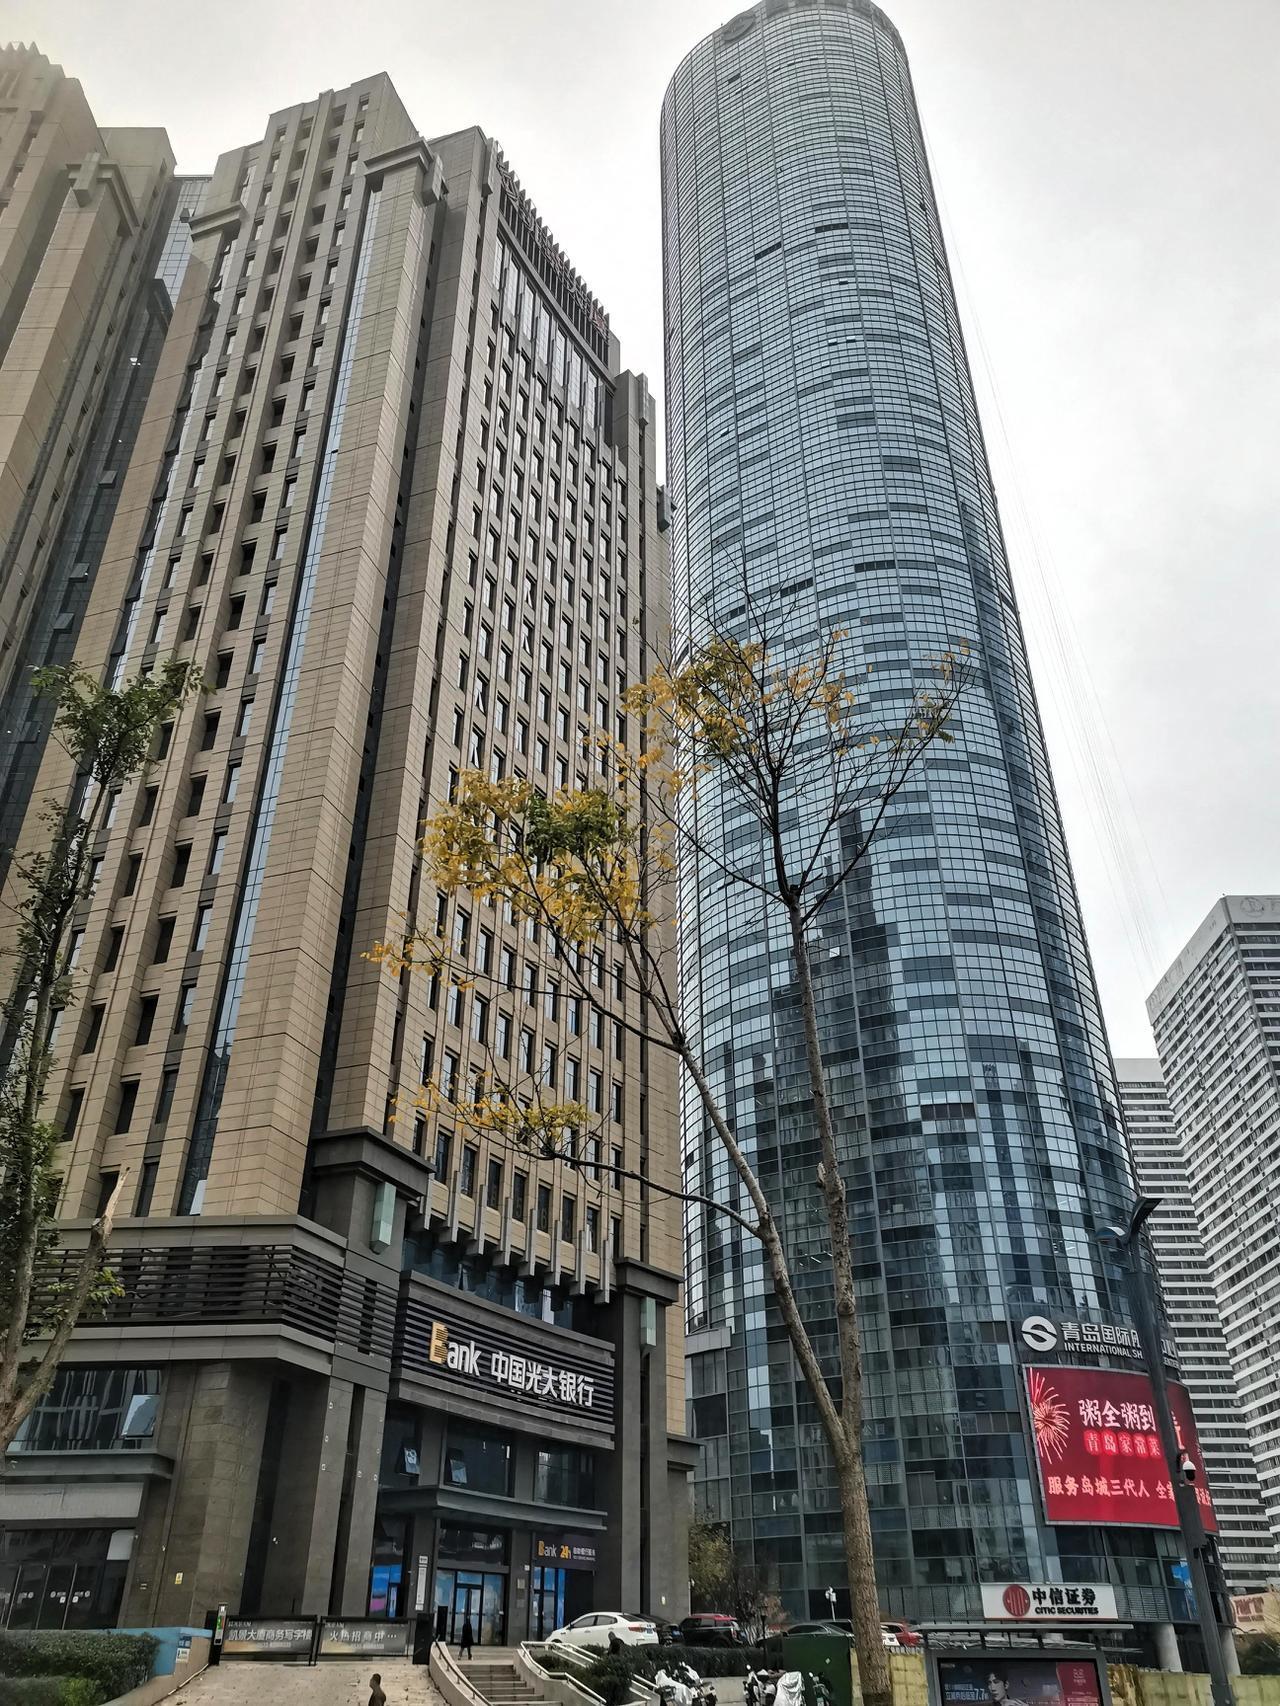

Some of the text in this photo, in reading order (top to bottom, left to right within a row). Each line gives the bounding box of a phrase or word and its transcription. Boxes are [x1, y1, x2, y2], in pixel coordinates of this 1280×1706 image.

[1063, 1342, 1131, 1359] INTERNATIONAL
[429, 1321, 595, 1407] Bank 中国光大银行
[1086, 1432, 1161, 1456] 青岛家常菜
[1047, 1475, 1150, 1498] 服务岛城三代人
[1031, 1587, 1096, 1606] 中信证券
[1034, 1606, 1099, 1615] CITIC SECURITIES
